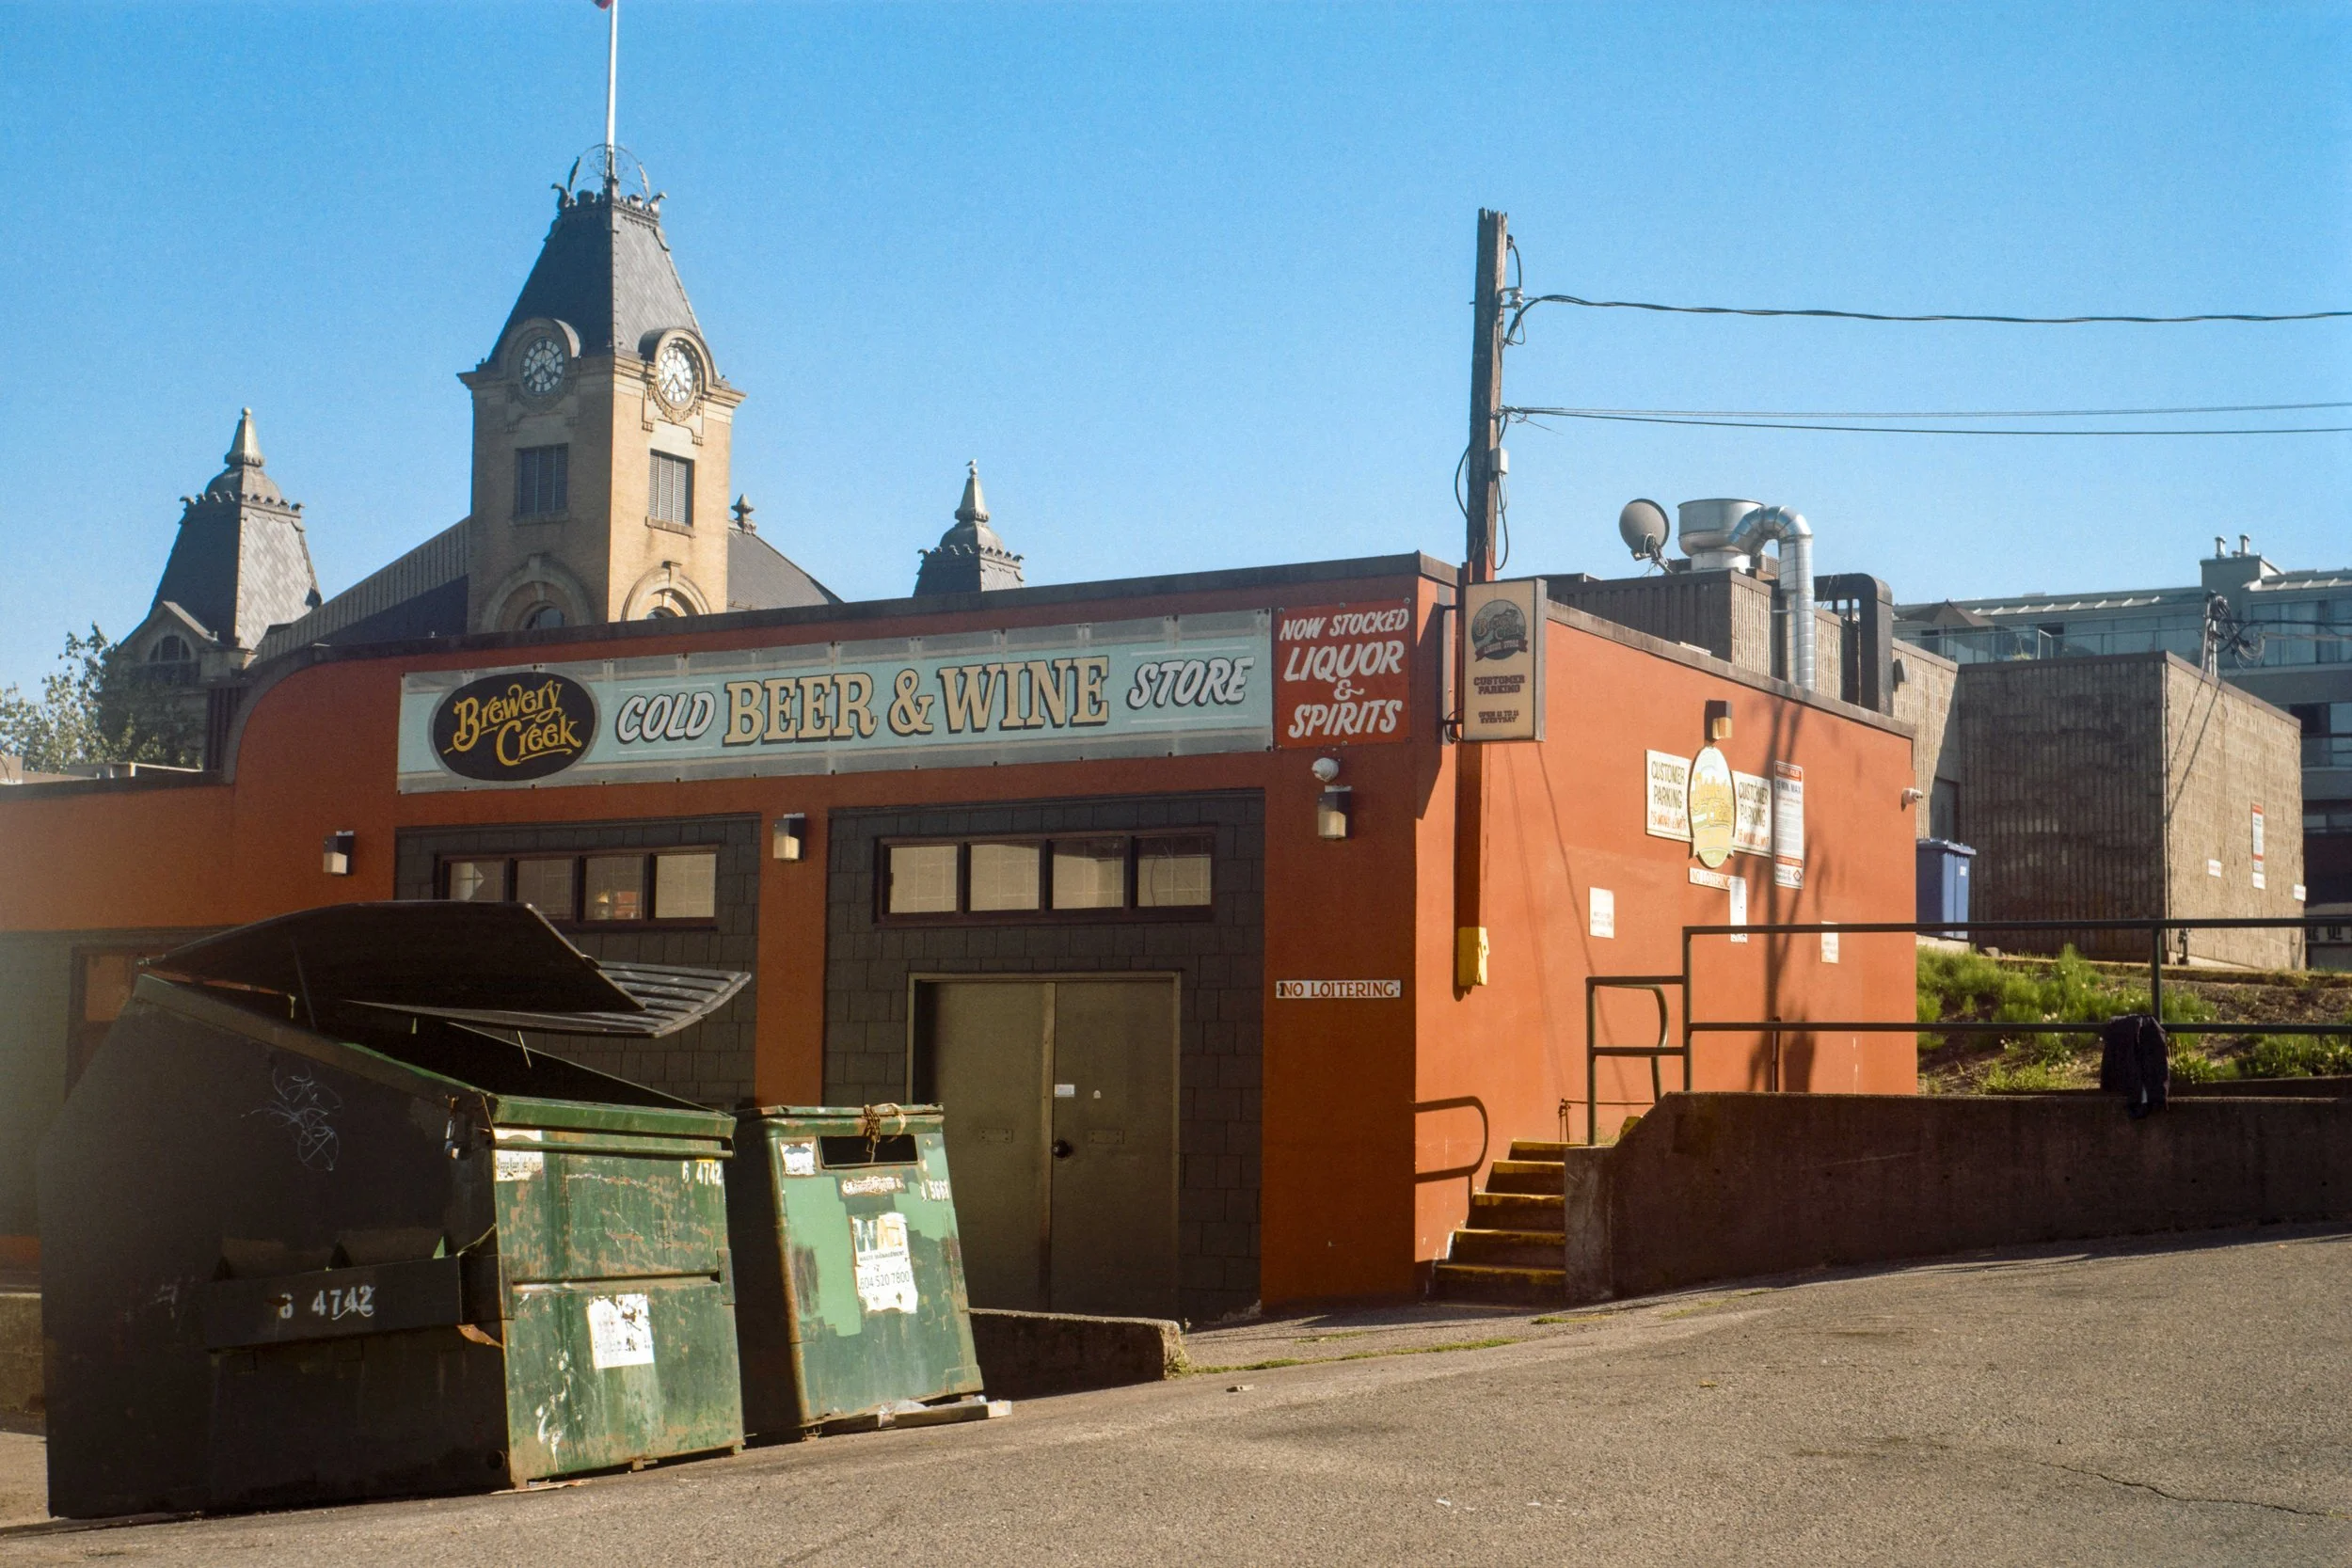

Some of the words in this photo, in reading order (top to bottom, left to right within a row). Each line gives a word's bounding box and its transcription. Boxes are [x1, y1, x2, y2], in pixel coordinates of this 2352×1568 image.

[1279, 617, 1327, 641] NOW
[1329, 609, 1409, 637] STOCKED
[1283, 641, 1405, 683] LIQUOR
[1333, 678, 1364, 701] &
[1473, 674, 1525, 686] CUSTOMER
[1478, 685, 1520, 694] PARKING
[615, 690, 716, 743] COLD
[723, 670, 879, 748] BEER
[887, 668, 934, 737] &
[936, 656, 1109, 735] WINE
[1126, 657, 1255, 710] STORE
[444, 679, 564, 753] Brewery
[1288, 699, 1403, 738] SPIRITS
[495, 716, 581, 767] Creek
[1651, 761, 1685, 784] CUSTOMER
[1653, 785, 1682, 809] PARKING
[1739, 782, 1769, 804] CUSTOMER
[1740, 804, 1766, 827] PARKING
[1692, 869, 1701, 882] NO
[1280, 982, 1304, 997] NO
[1311, 982, 1394, 997] LOITERING
[682, 1161, 689, 1183] 6
[696, 1162, 722, 1185] 4742
[860, 1276, 874, 1290] 604
[875, 1274, 890, 1287] 520
[891, 1271, 910, 1284] 7800
[311, 1285, 373, 1316] 4742
